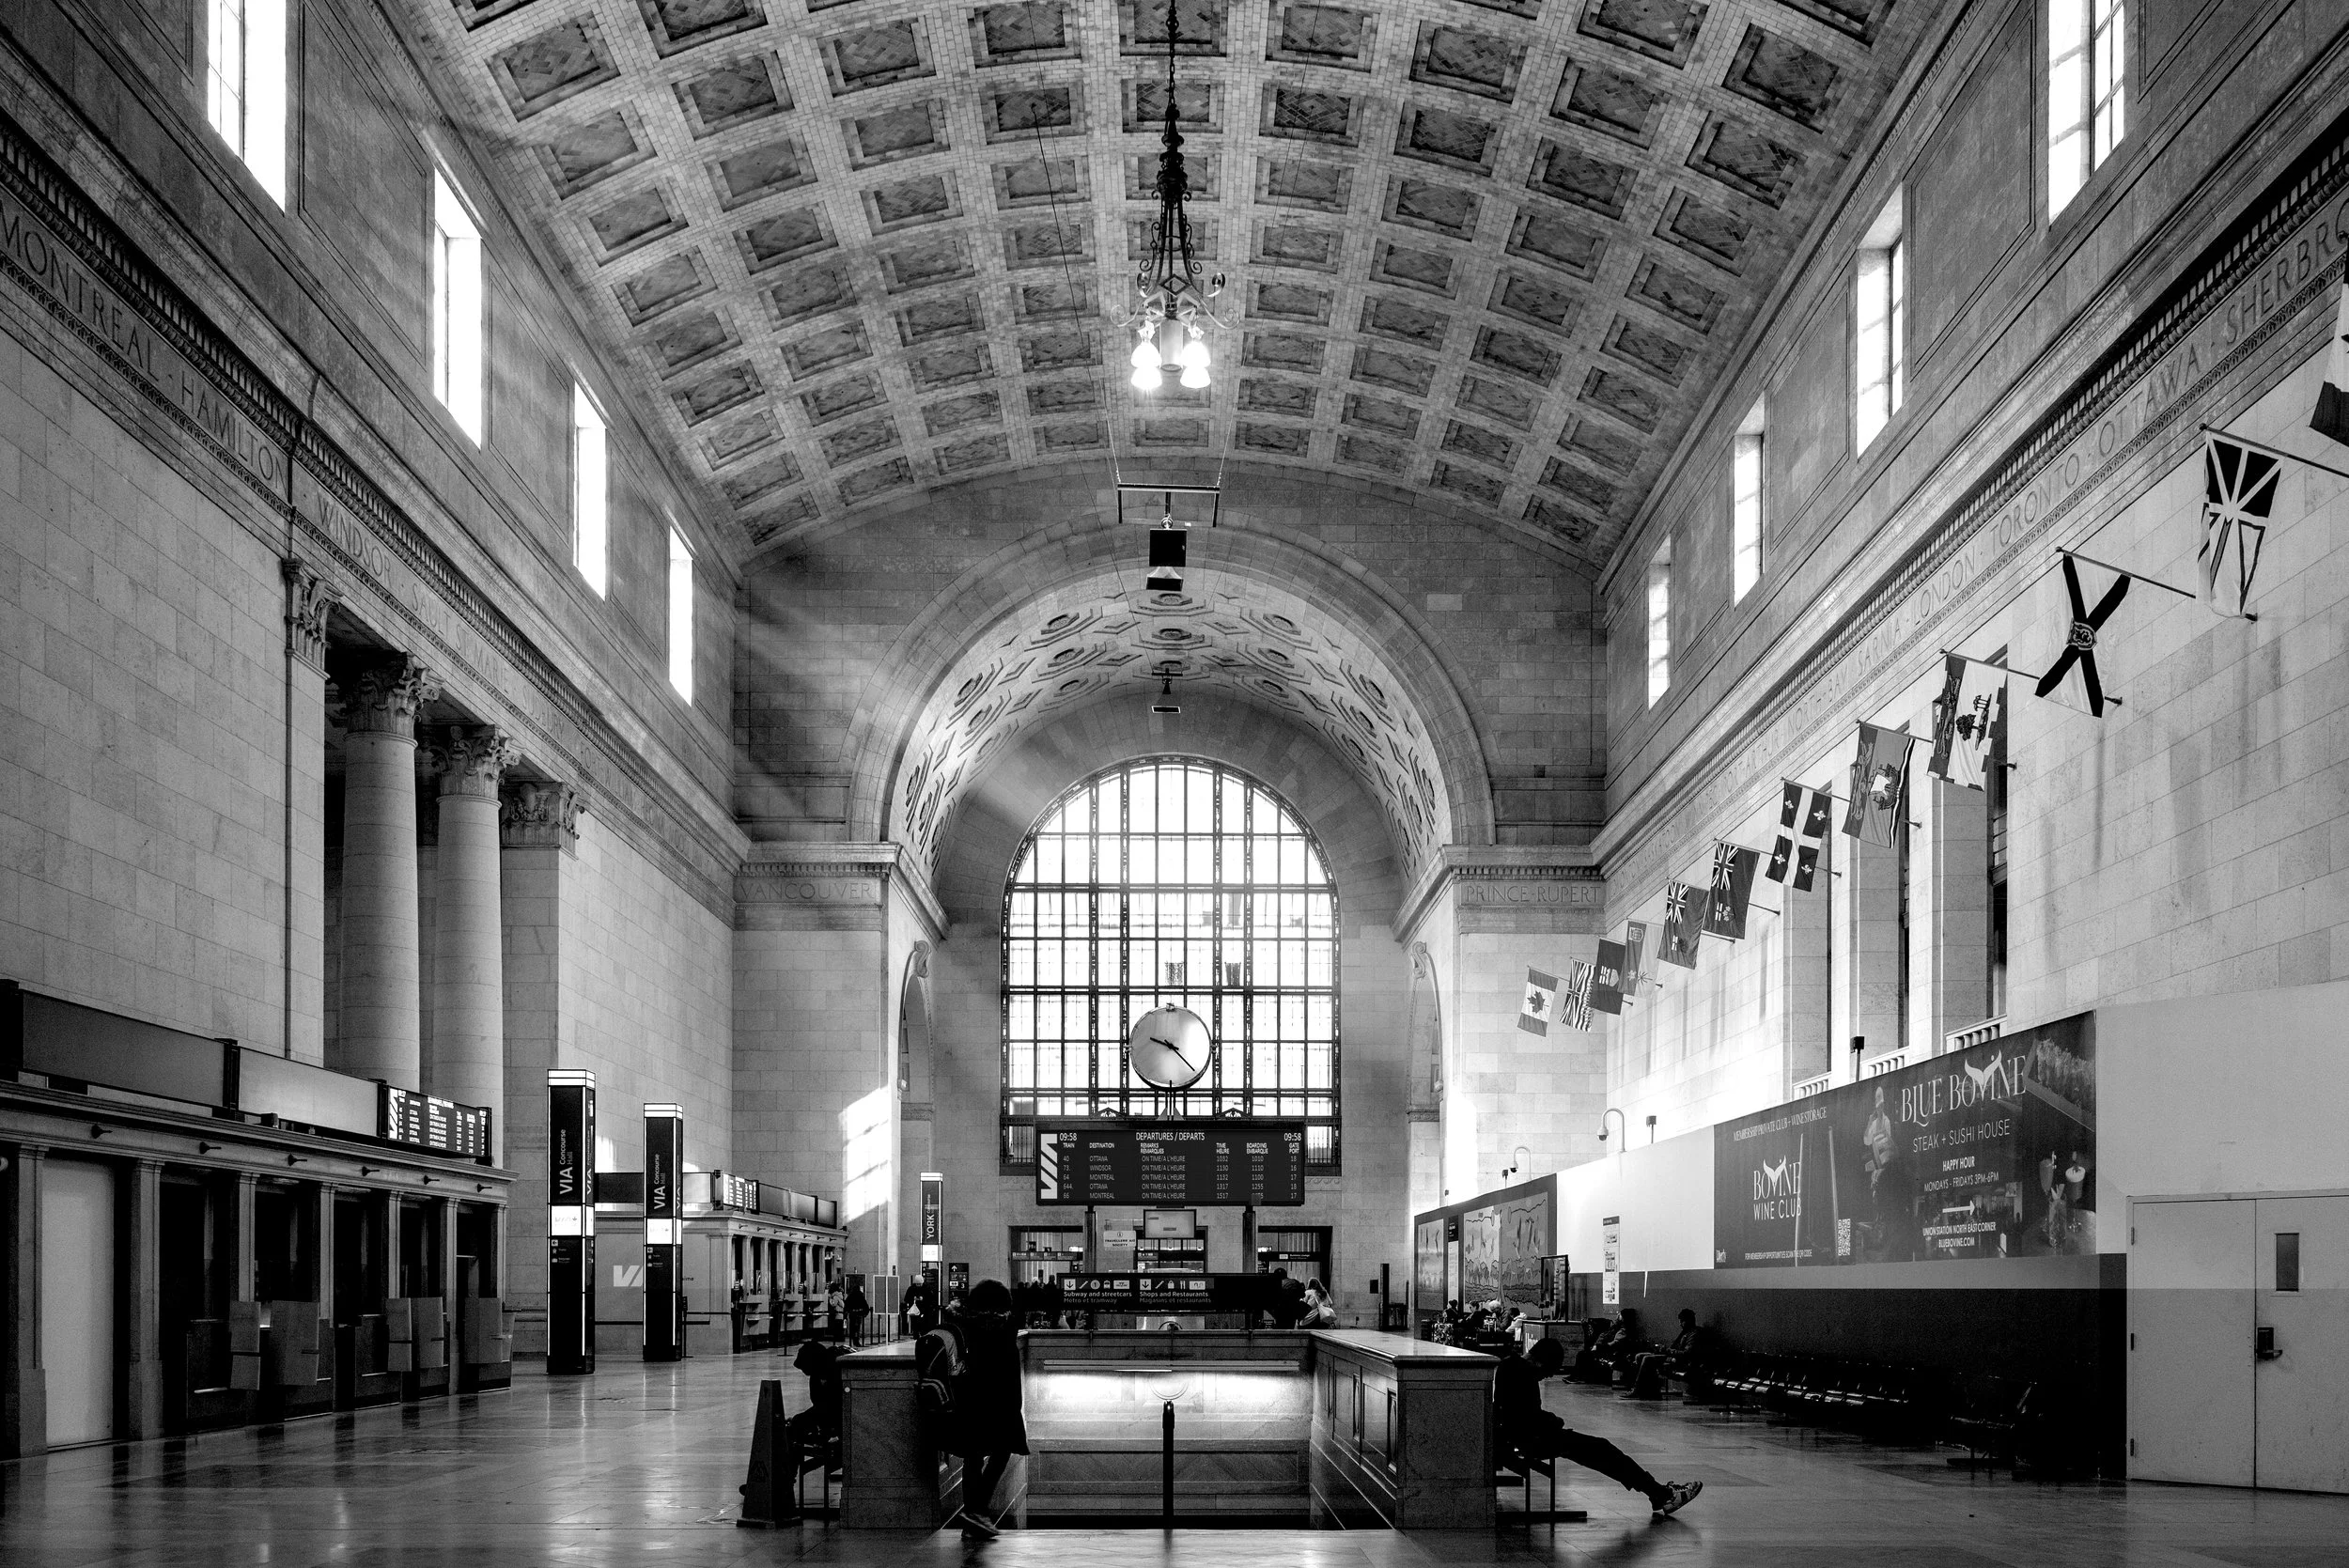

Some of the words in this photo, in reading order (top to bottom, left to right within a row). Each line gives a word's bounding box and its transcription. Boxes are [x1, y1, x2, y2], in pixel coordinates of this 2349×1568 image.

[181, 372, 288, 497] HAMILTON
[317, 492, 393, 586] WINDSOR
[1858, 618, 1902, 676] SARNIA
[1913, 546, 1975, 626] LONDON
[1989, 453, 2079, 553] TORONTO
[2099, 343, 2201, 456] OTTAWA
[739, 882, 875, 899] VANCOUVER
[1466, 885, 1530, 902] PRINCE
[1537, 885, 1601, 902] RUPERT
[1901, 1078, 1943, 1127] BLUE
[1949, 1049, 2027, 1111] BOVINE
[1059, 1132, 1078, 1141] 09:58
[1135, 1132, 1174, 1141] DEPARTURES
[1178, 1132, 1206, 1141] DEPARTS
[1283, 1132, 1302, 1141] 09:58
[1913, 1130, 1939, 1153] STEAK
[1949, 1126, 1974, 1146] SUSHI
[1978, 1118, 2011, 1141] HOUSE
[1942, 1158, 1959, 1172] HAPPY
[1960, 1156, 1975, 1169] HOUR
[559, 1167, 573, 1195] VIA
[1753, 1155, 1801, 1201] BOVINE
[1924, 1178, 1950, 1192] MONDAYS
[1952, 1175, 1973, 1188] FRIDAYS
[1974, 1172, 1999, 1186] 3PM-6PM
[654, 1186, 666, 1210] VIA
[1753, 1201, 1775, 1221] WINE
[1778, 1197, 1802, 1219] CLUB
[926, 1214, 935, 1239] YORK
[1922, 1226, 1936, 1236] UNION
[1936, 1225, 1952, 1234] STATION
[1952, 1223, 1968, 1234] NORTH
[1978, 1222, 1997, 1232] CORNER
